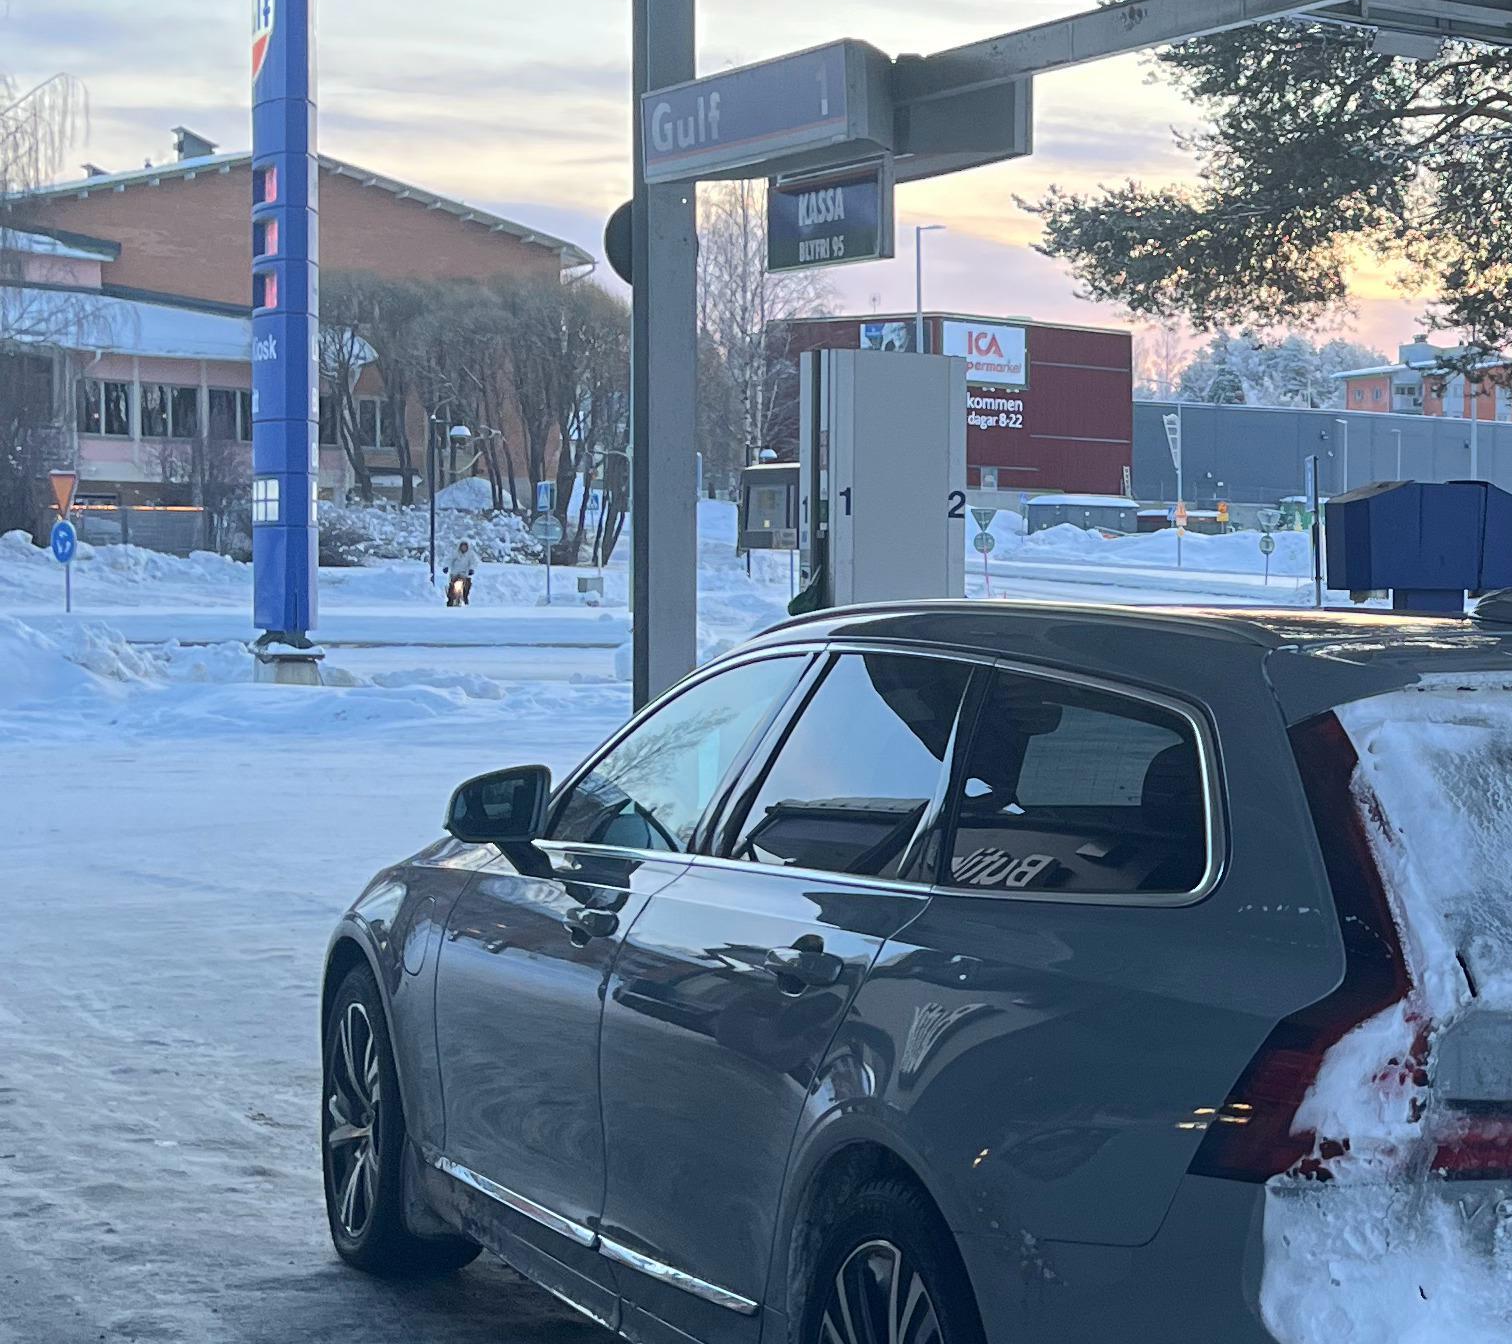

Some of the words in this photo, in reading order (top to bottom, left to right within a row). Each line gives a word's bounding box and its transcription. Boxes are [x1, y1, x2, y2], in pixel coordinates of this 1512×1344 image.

[816, 63, 829, 116] 1
[651, 92, 721, 152] Gulf
[799, 187, 845, 227] KASSA
[799, 237, 830, 262] BLYFRI
[832, 235, 845, 257] 95
[967, 331, 1004, 358] ICA
[966, 392, 1023, 412] kommen
[968, 411, 998, 430] dagar
[802, 496, 809, 524] 1
[839, 487, 851, 516] 1
[948, 490, 966, 519] 2
